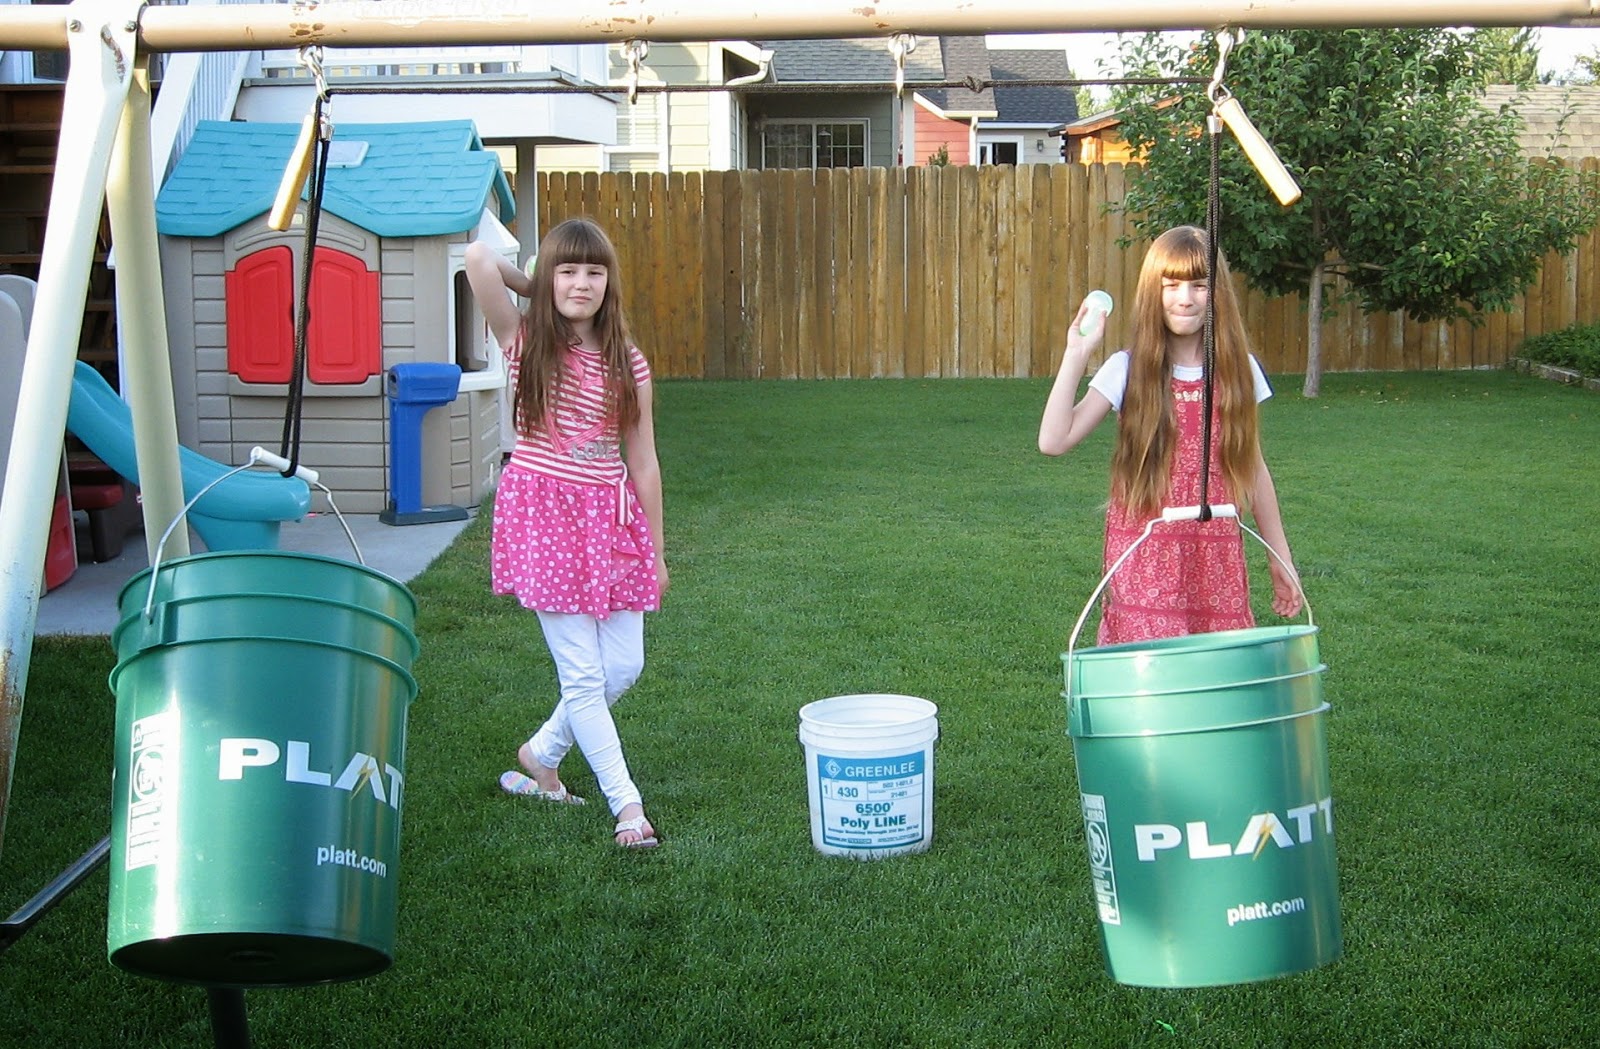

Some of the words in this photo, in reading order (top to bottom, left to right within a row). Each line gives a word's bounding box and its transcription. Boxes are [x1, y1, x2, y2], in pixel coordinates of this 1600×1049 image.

[218, 737, 402, 810] PLAT
[845, 761, 915, 777] GREENLEE
[837, 787, 859, 798] 430
[840, 816, 870, 830] Poly
[874, 814, 907, 828] LINE
[1134, 795, 1332, 861] PLATT
[316, 845, 387, 878] platt.com
[1226, 896, 1305, 926] platt.com
